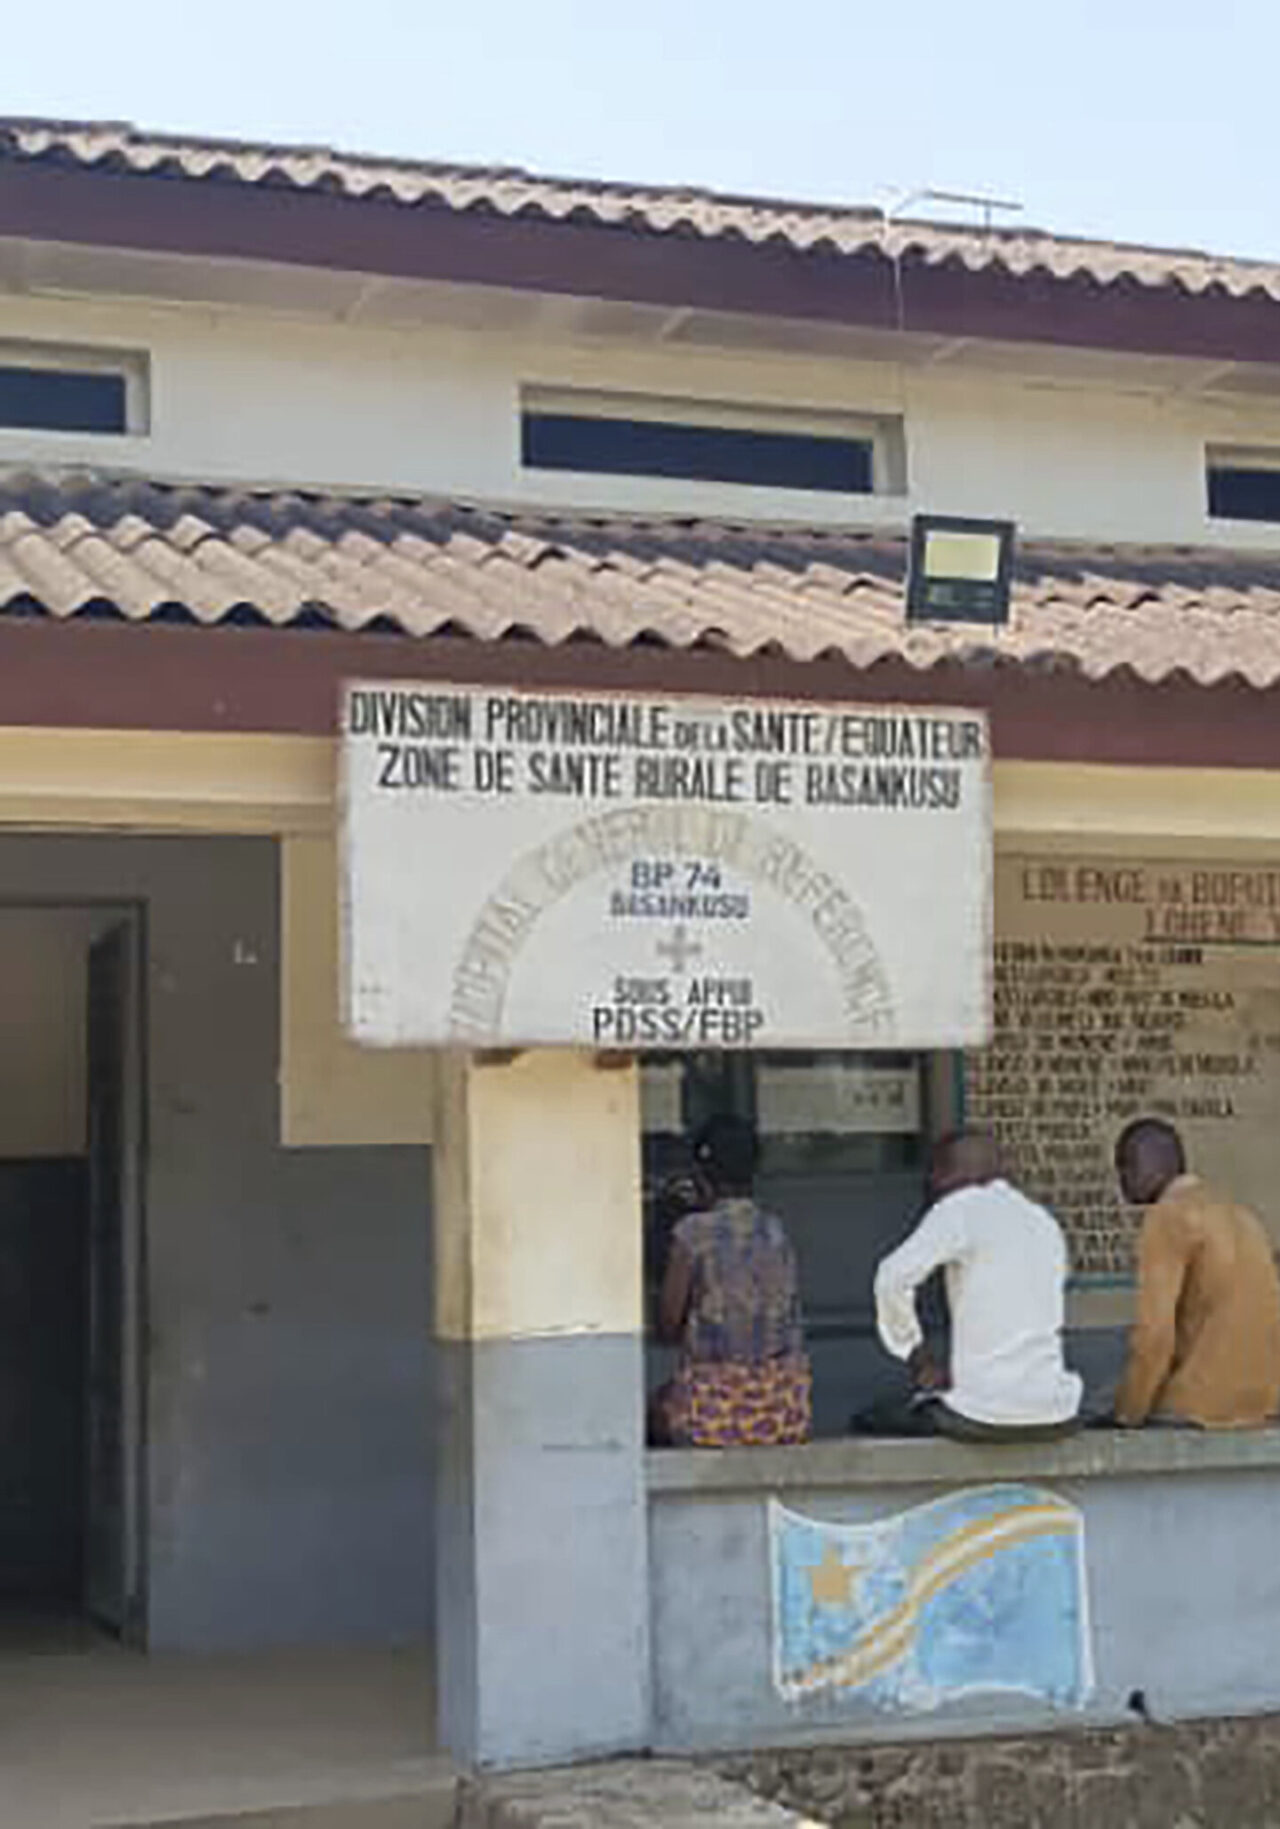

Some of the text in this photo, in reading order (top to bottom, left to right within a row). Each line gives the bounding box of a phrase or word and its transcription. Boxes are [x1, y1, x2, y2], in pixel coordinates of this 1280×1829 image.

[350, 691, 471, 739] DIVISION
[487, 699, 669, 749] PROVINCIALE
[731, 710, 983, 758] SANTE/EQUATEUR
[377, 745, 962, 808] ZONE DE SANTE RURALE DE BASANKUSU
[632, 861, 720, 888] BP 74
[593, 1005, 763, 1042] PDSS/FBP
